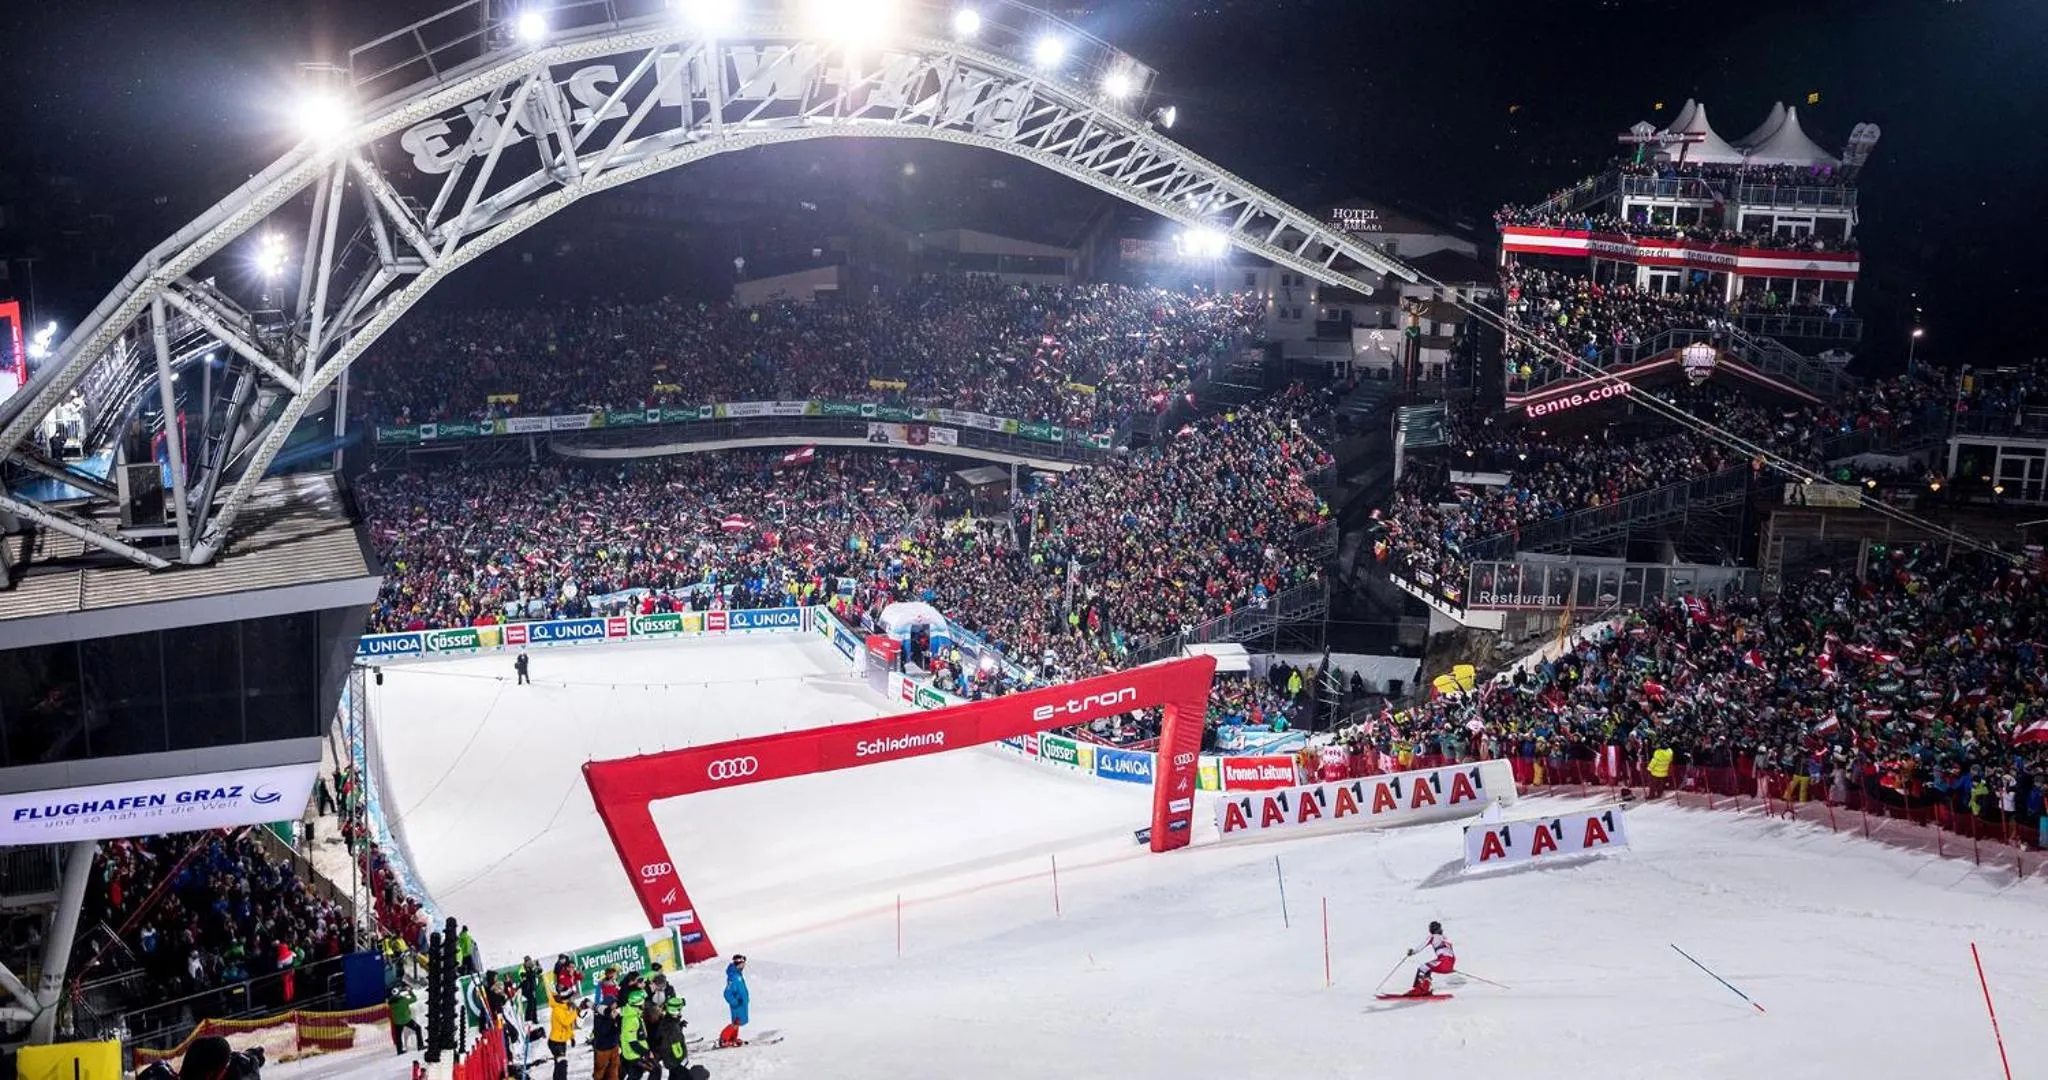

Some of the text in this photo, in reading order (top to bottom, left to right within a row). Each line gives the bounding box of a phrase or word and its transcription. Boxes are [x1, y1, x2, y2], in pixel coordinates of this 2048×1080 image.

[1333, 208, 1379, 219] HOTEL
[1526, 381, 1632, 418] tenne.com
[1479, 591, 1562, 606] Restaurant
[632, 616, 680, 635] Gösser
[753, 612, 799, 626] UNIQA
[555, 623, 604, 638] UNIQA
[369, 638, 421, 652] UNIQA
[427, 632, 476, 651] Gösser
[1033, 687, 1137, 721] e-tron
[856, 731, 945, 756] Schladming
[1042, 735, 1076, 761] Gösser
[1114, 760, 1150, 776] UNIQA
[1226, 764, 1293, 783] Kronen Zeitung
[13, 785, 244, 821] FLUGHAFEN GRAZ
[1223, 767, 1482, 832] A1 A1 A1 A1 A1 A1 A1
[82, 815, 101, 825] so
[109, 811, 137, 821] nah
[145, 808, 163, 817] ist
[171, 805, 194, 815] die
[201, 801, 238, 811] Welt
[1480, 810, 1615, 862] A1 A1 A1
[581, 943, 639, 970] Vernünftig
